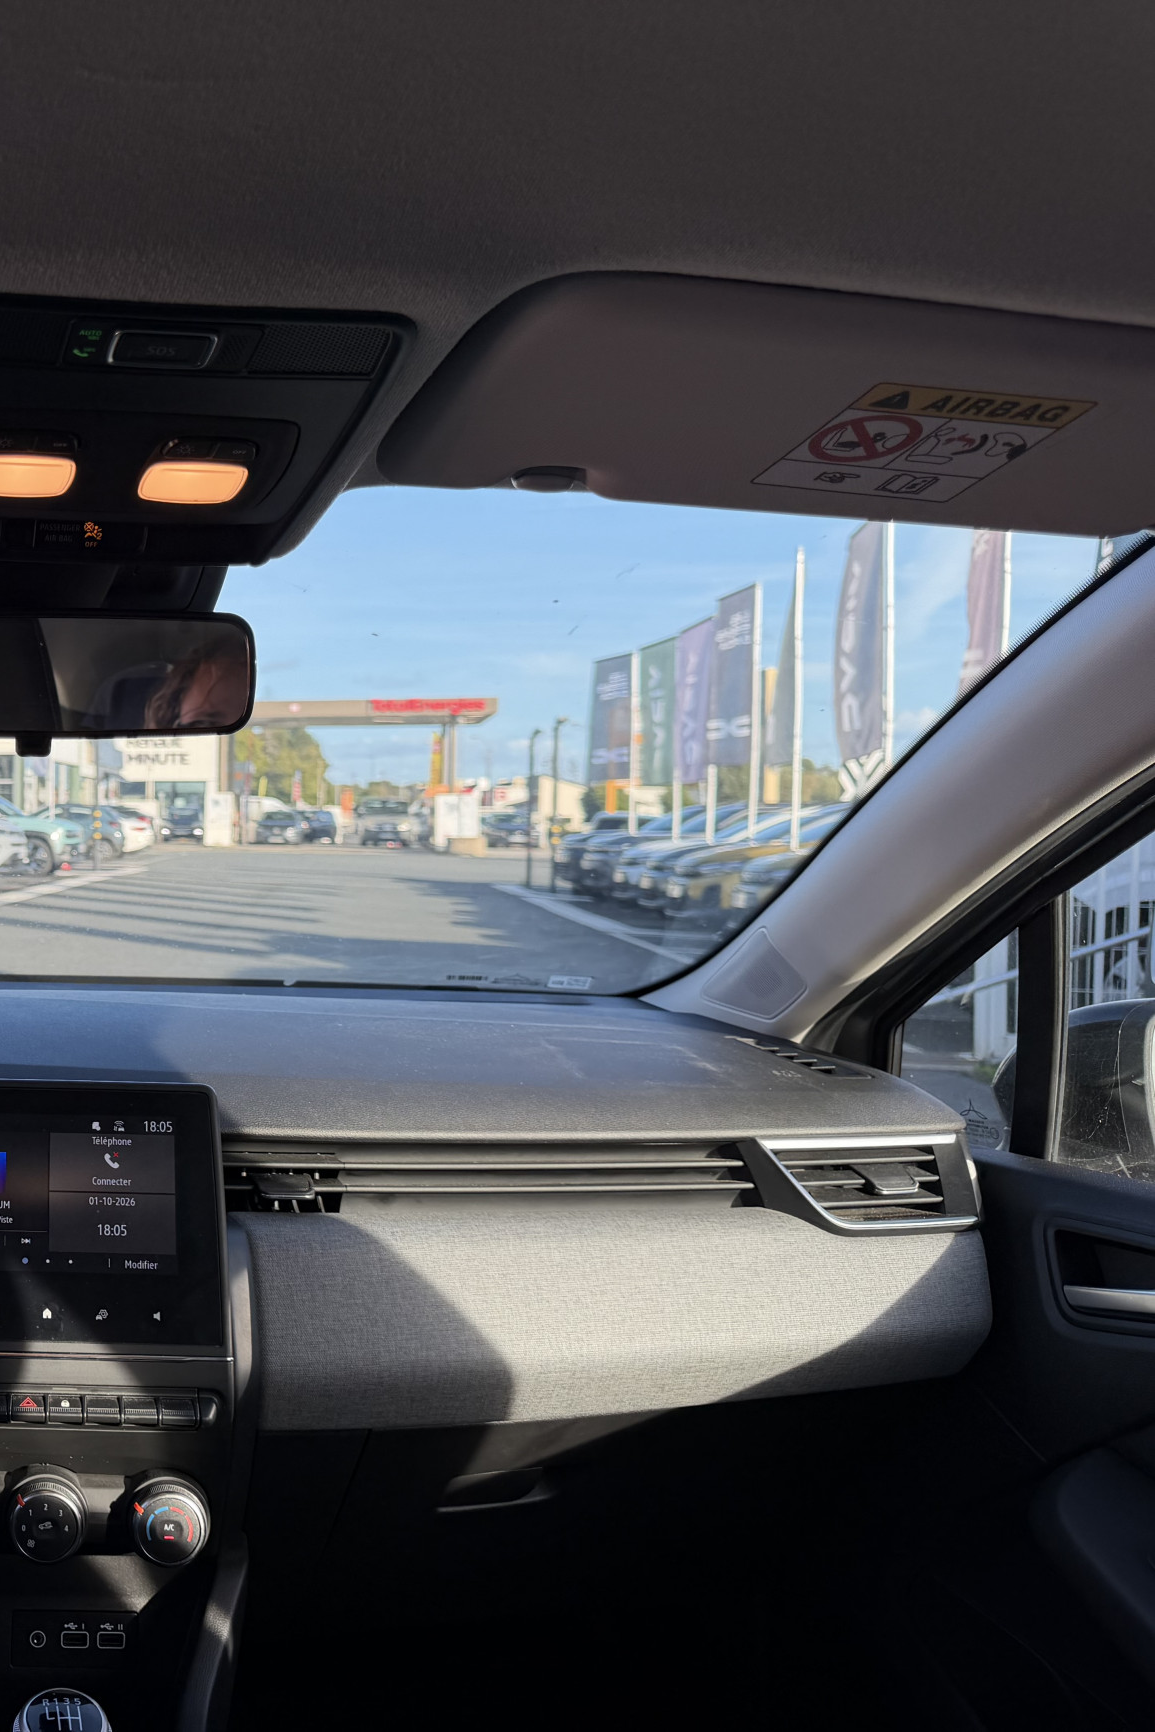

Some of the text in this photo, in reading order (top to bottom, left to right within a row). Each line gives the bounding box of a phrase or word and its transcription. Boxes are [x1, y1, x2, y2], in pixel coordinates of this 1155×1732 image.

[921, 395, 1072, 423] AIRBAG
[127, 752, 190, 766] MINUTE
[143, 1120, 173, 1133] 18:05
[92, 1136, 132, 1147] Téléphone
[92, 1176, 132, 1186] Connecter
[88, 1196, 136, 1206] 01-10-2026
[97, 1223, 127, 1236] 18:05
[124, 1259, 159, 1270] Modifier
[43, 1503, 48, 1511] 2
[58, 1509, 63, 1517] 3
[21, 1524, 26, 1532] 0
[64, 1524, 69, 1532] 4
[164, 1523, 175, 1532] A/C
[42, 1697, 82, 1706] R 1 3 5
